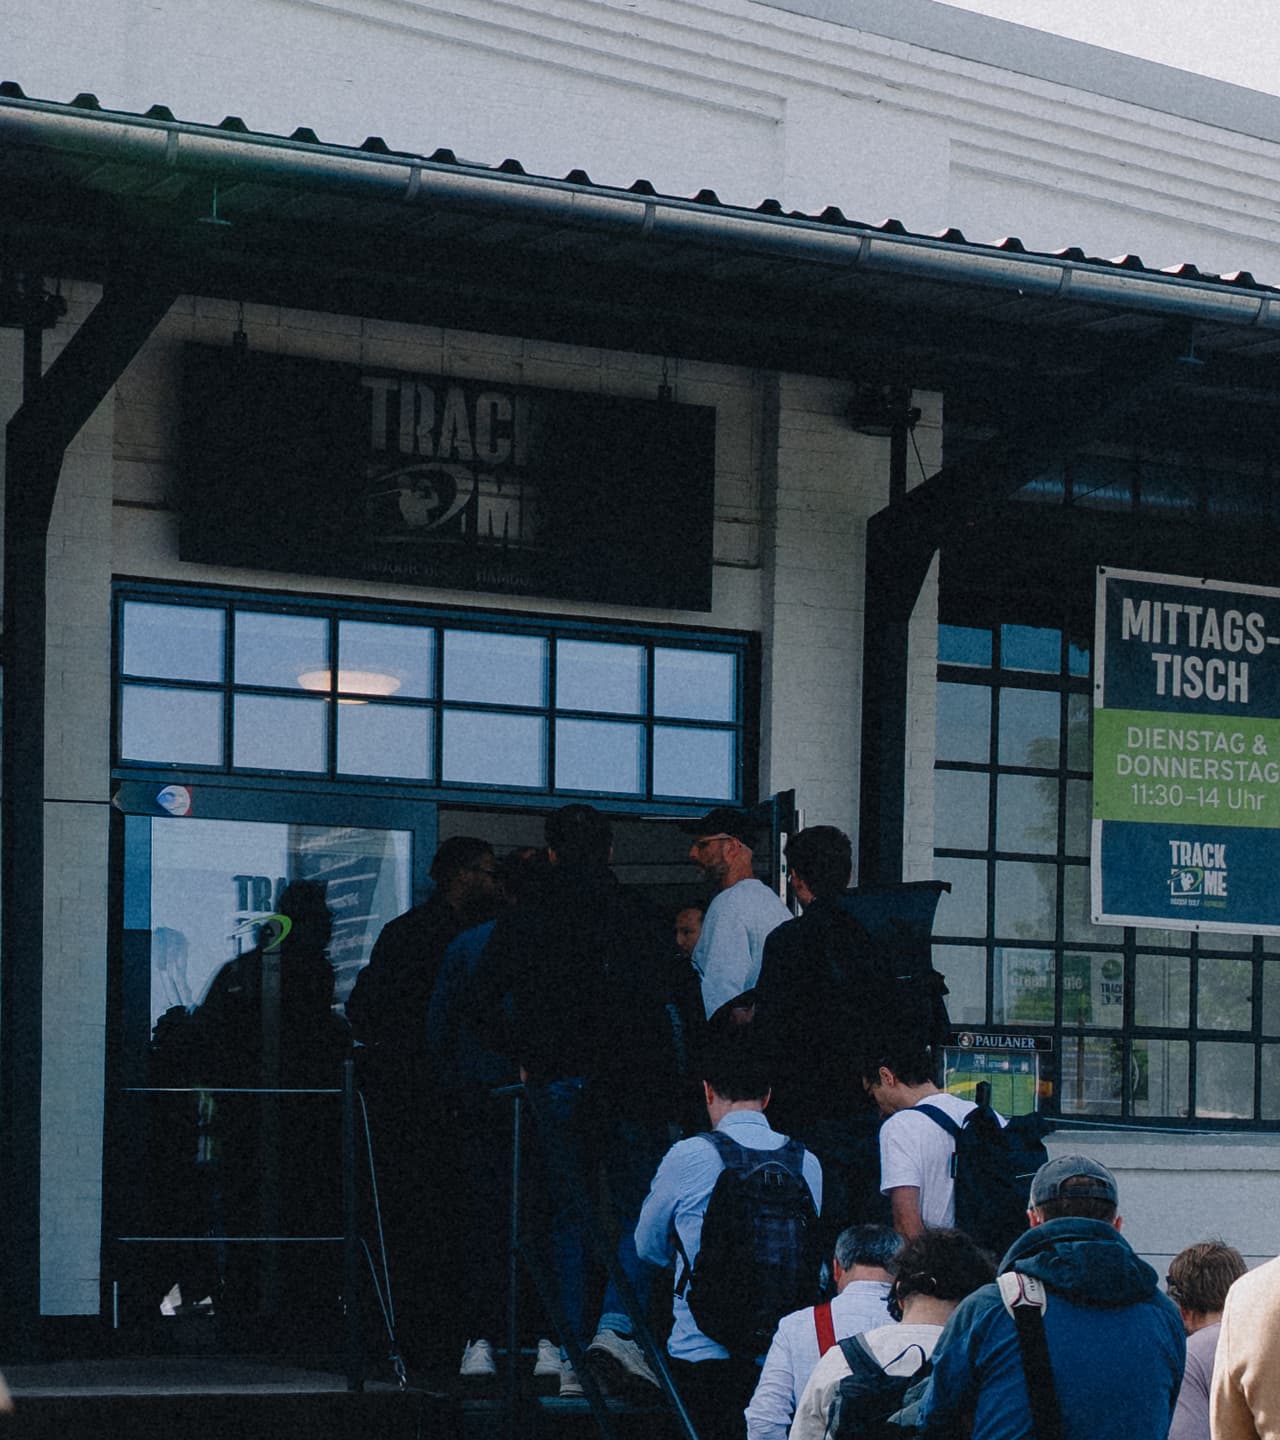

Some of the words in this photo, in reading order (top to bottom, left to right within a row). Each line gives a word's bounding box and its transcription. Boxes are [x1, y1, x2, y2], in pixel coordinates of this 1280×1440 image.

[1121, 597, 1280, 655] MITTAGS-
[1151, 652, 1249, 704] TISCH
[1127, 726, 1246, 754] DIENSTAG
[1252, 734, 1268, 756] &
[1116, 753, 1280, 784] DONNERSTAG
[1227, 788, 1265, 810] Uhr
[1169, 840, 1227, 869] TRACK
[1204, 870, 1228, 897] ME
[975, 1035, 1036, 1049] PAULANER
